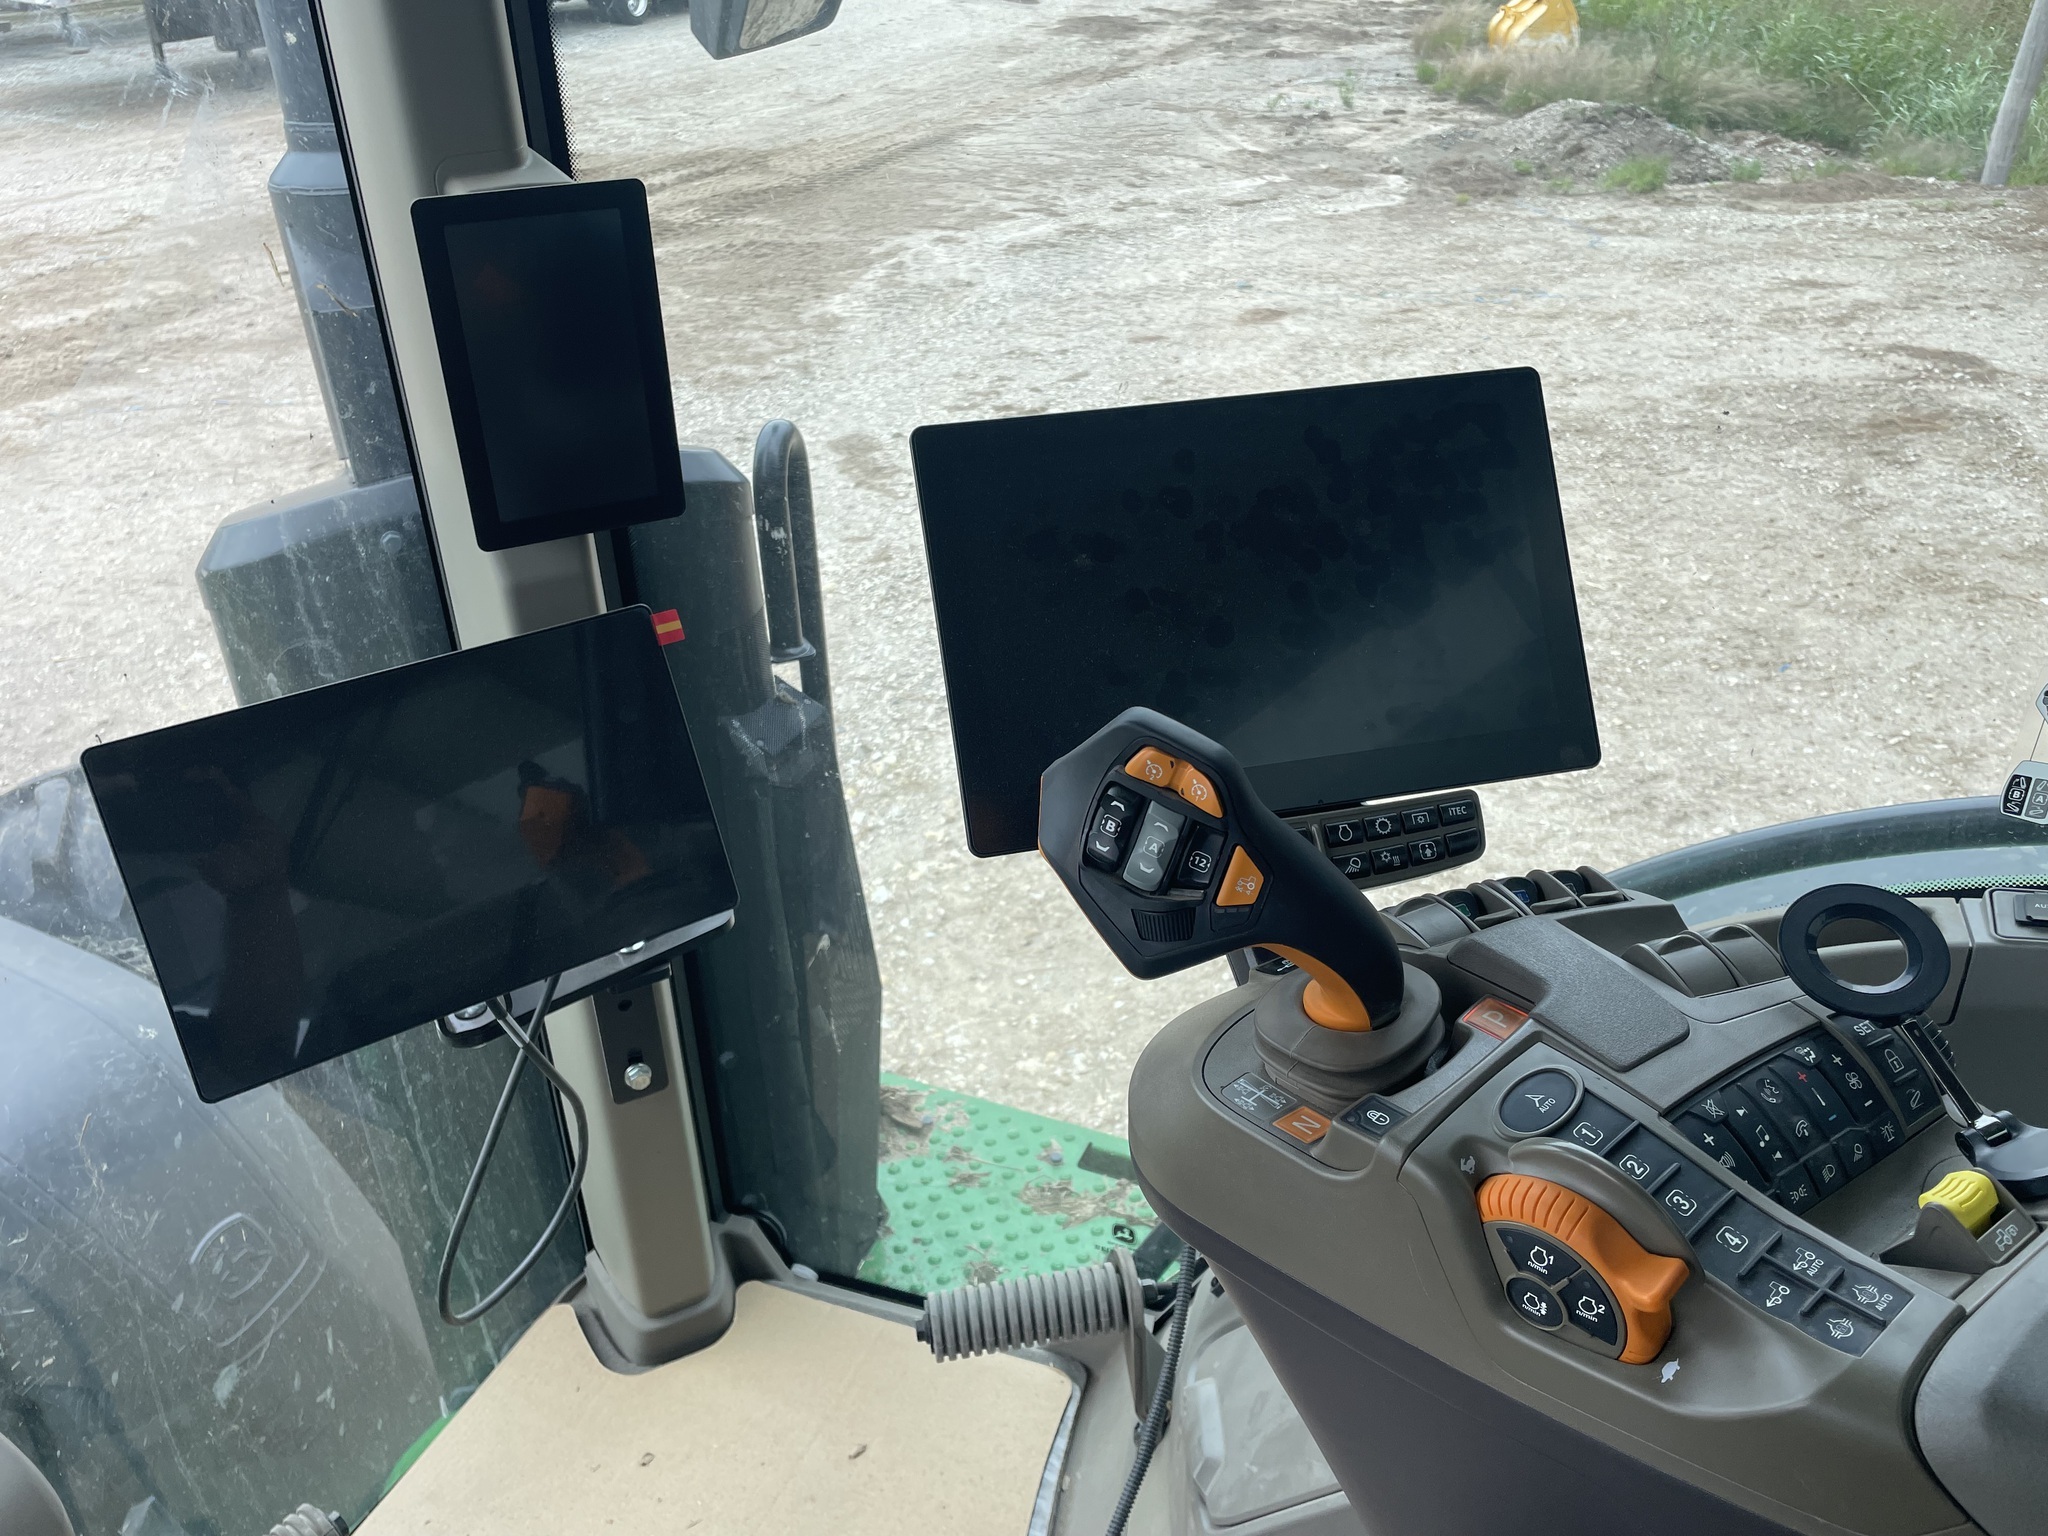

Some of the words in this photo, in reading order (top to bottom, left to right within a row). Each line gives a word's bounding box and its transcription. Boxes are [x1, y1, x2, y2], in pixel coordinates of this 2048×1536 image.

[2012, 791, 2021, 799] B
[2035, 795, 2044, 803] A
[1448, 806, 1468, 816] ITEC
[1105, 819, 1116, 832] B
[1148, 842, 1158, 854] A
[1194, 856, 1207, 868] 12
[1481, 1010, 1507, 1028] P
[1853, 1020, 1876, 1036] SET
[1538, 1097, 1556, 1114] AUTO
[1291, 1115, 1322, 1135] N
[1581, 1127, 1597, 1139] 1
[1626, 1160, 1645, 1175] 2
[1672, 1195, 1690, 1210] 3
[1724, 1231, 1742, 1246] 4
[1548, 1255, 1555, 1265] 1
[1527, 1260, 1548, 1275] n/min
[1806, 1258, 1824, 1277] AUTO
[1875, 1293, 1893, 1311] AUTO
[1521, 1303, 1541, 1317] n/min
[1575, 1309, 1598, 1323] n/min
[1597, 1304, 1606, 1315] 2
